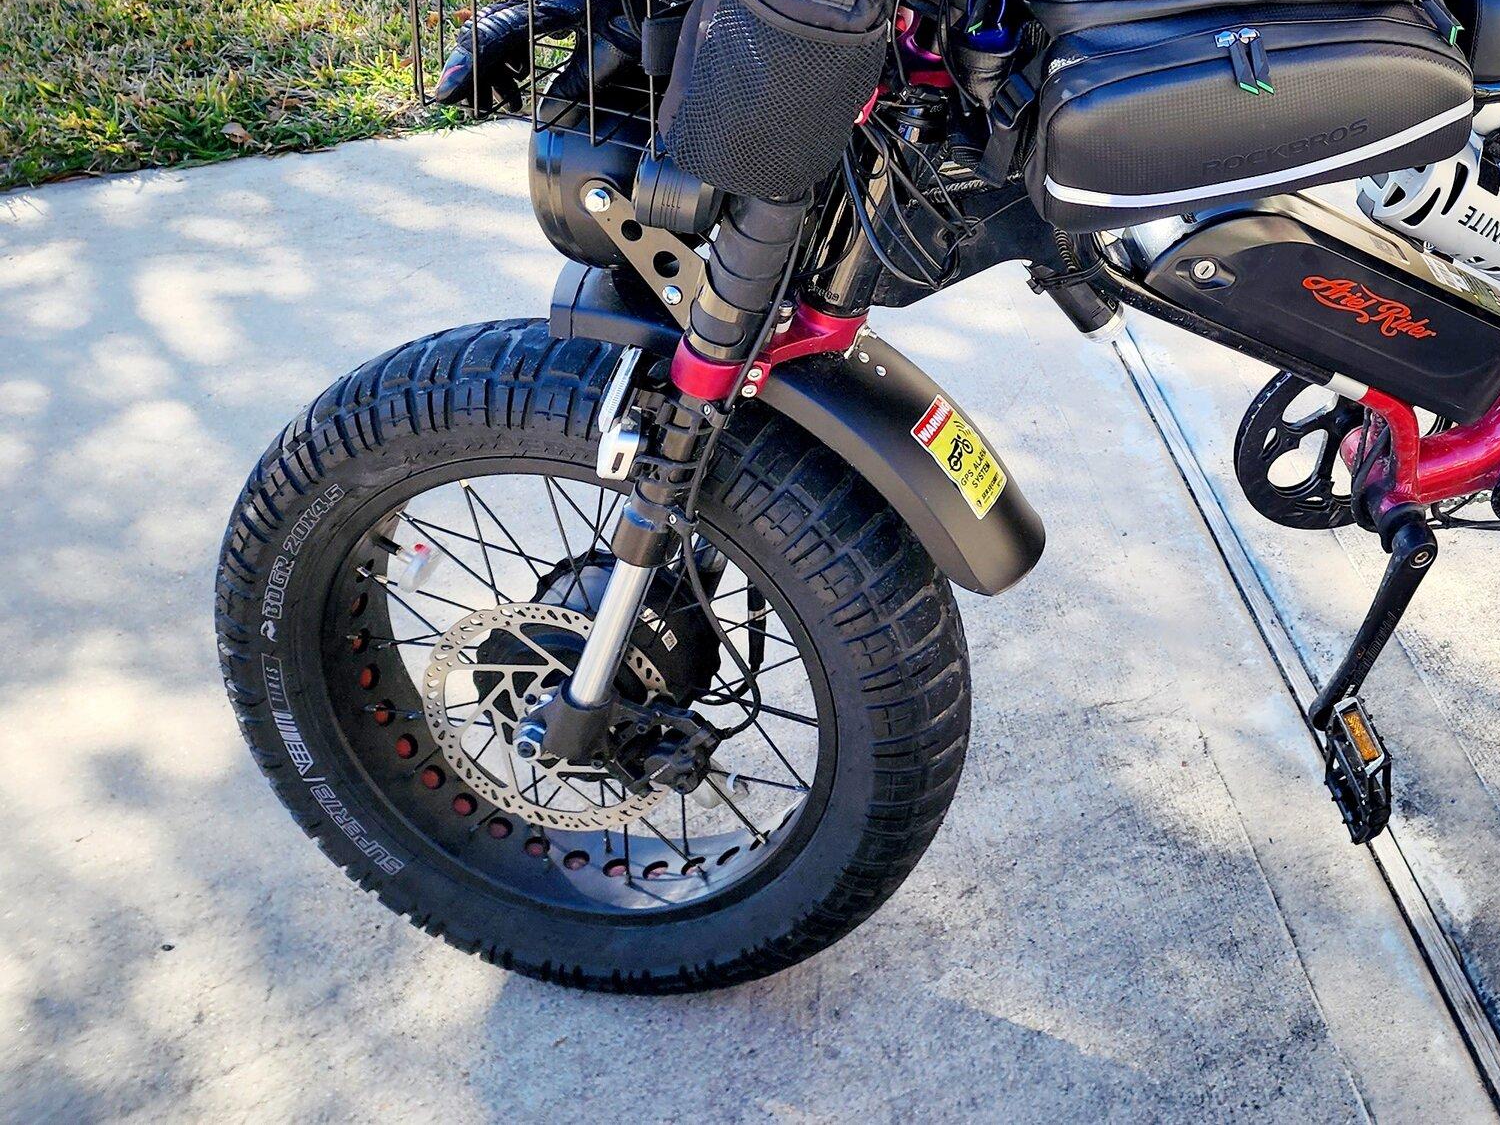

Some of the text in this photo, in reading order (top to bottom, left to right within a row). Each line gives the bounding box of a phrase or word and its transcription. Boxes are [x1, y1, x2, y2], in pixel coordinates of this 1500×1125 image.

[1202, 118, 1369, 174] ROCKBROS
[1302, 276, 1437, 339] Ariel Rider
[917, 403, 953, 443] WARNING
[960, 448, 988, 487] GPS ALARM
[971, 461, 991, 489] SYSTEM
[261, 555, 295, 620] BDGR
[282, 483, 346, 556] 20X4.5
